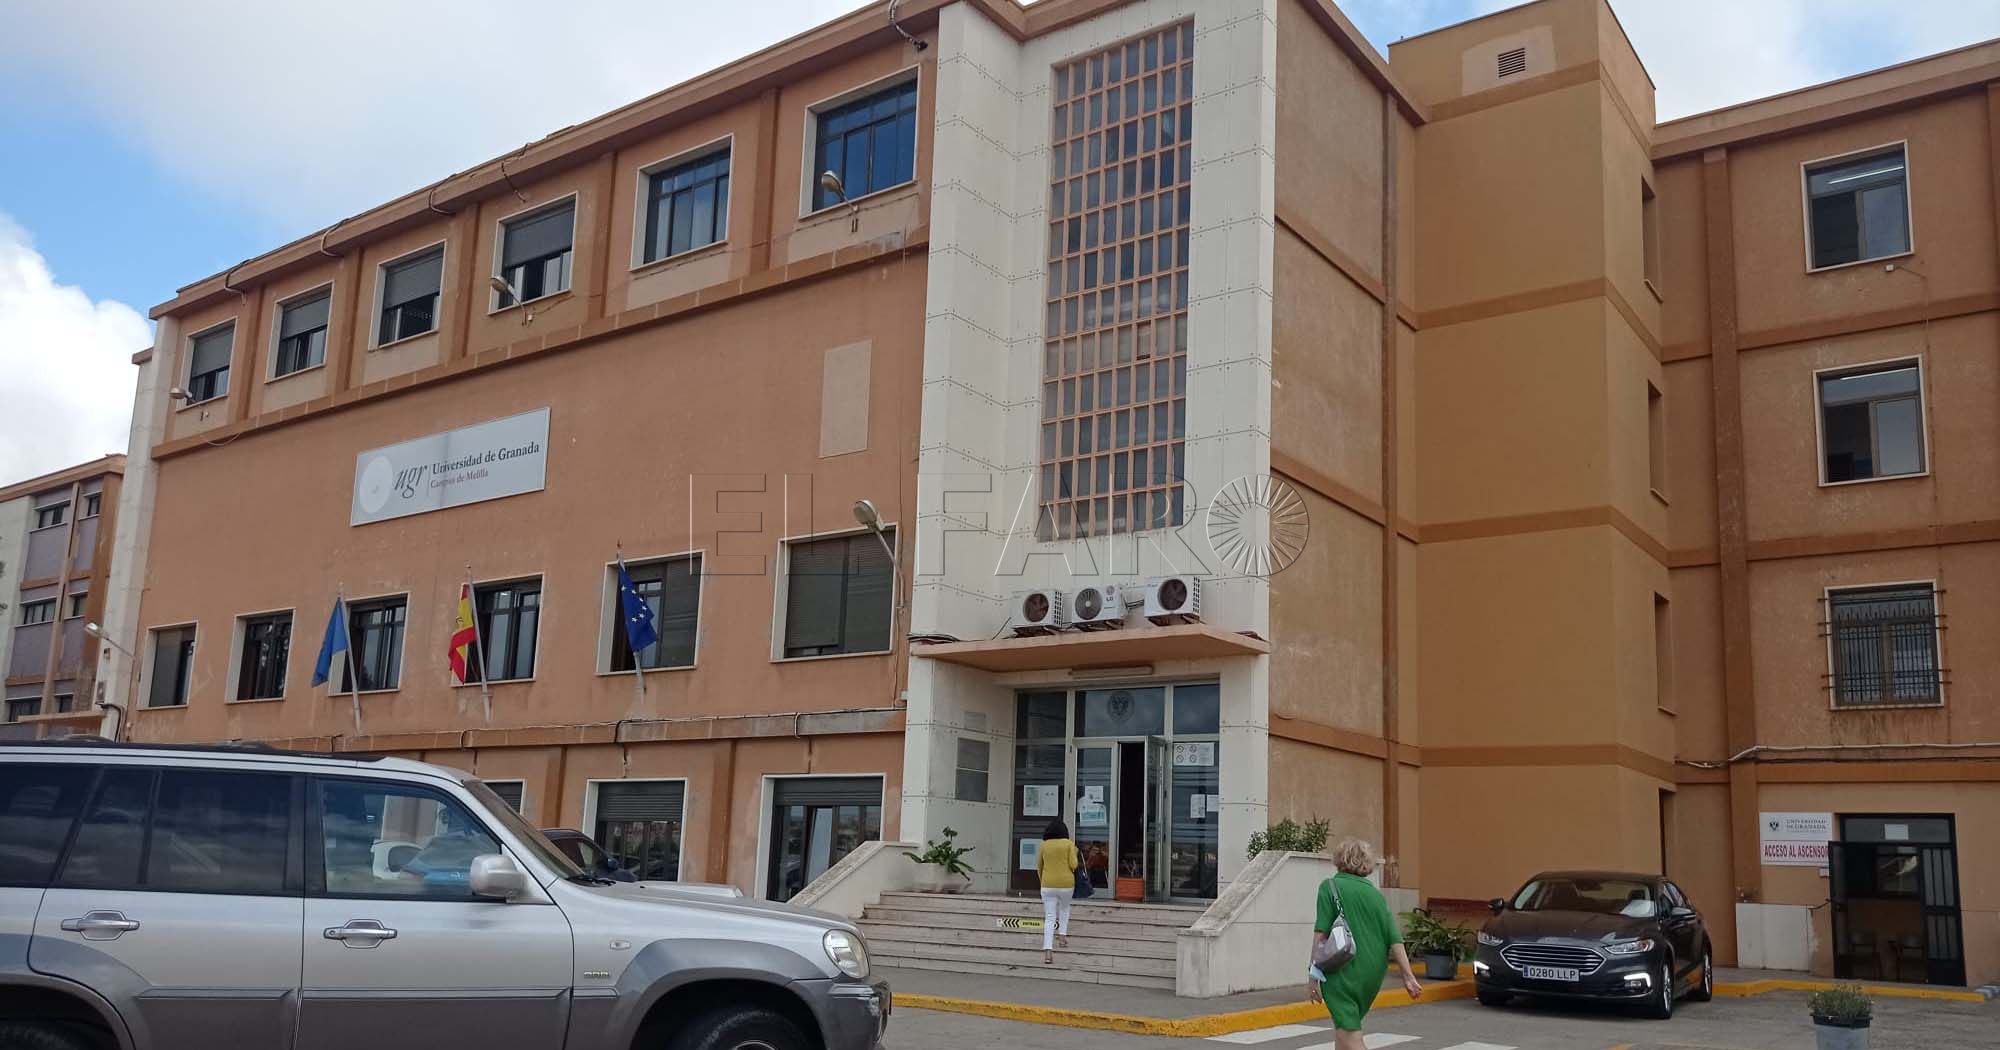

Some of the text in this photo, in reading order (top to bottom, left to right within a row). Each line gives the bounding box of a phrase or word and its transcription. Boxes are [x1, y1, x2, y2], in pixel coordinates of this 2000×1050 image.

[432, 441, 540, 475] Universidad de Granada
[394, 465, 428, 499] ugr
[1764, 844, 1788, 858] ACCESO
[1789, 844, 1797, 858] AL
[1530, 967, 1576, 980] 0280 LLP
